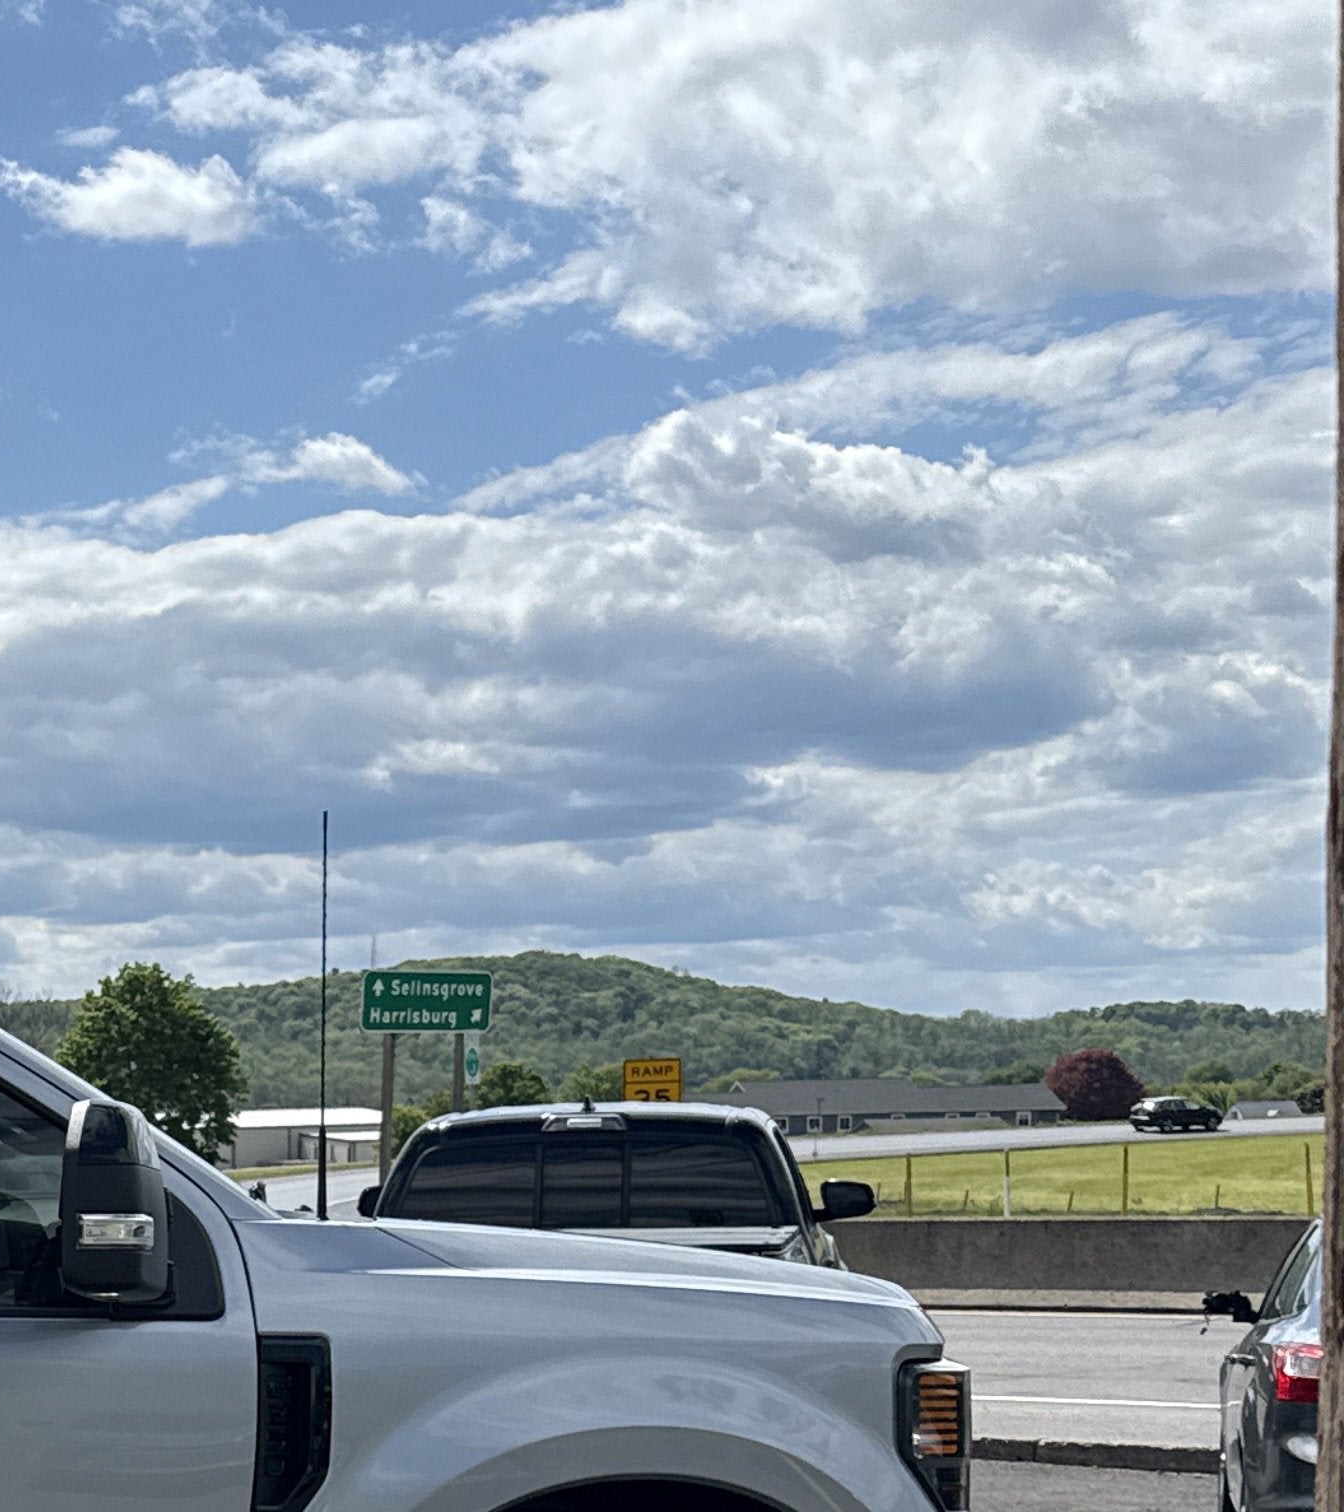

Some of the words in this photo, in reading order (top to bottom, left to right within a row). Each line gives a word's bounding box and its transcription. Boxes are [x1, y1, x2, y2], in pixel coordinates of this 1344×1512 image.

[391, 979, 483, 1001] Selinsgrove
[369, 1007, 458, 1028] Harrisburg
[630, 1065, 674, 1077] RAMP
